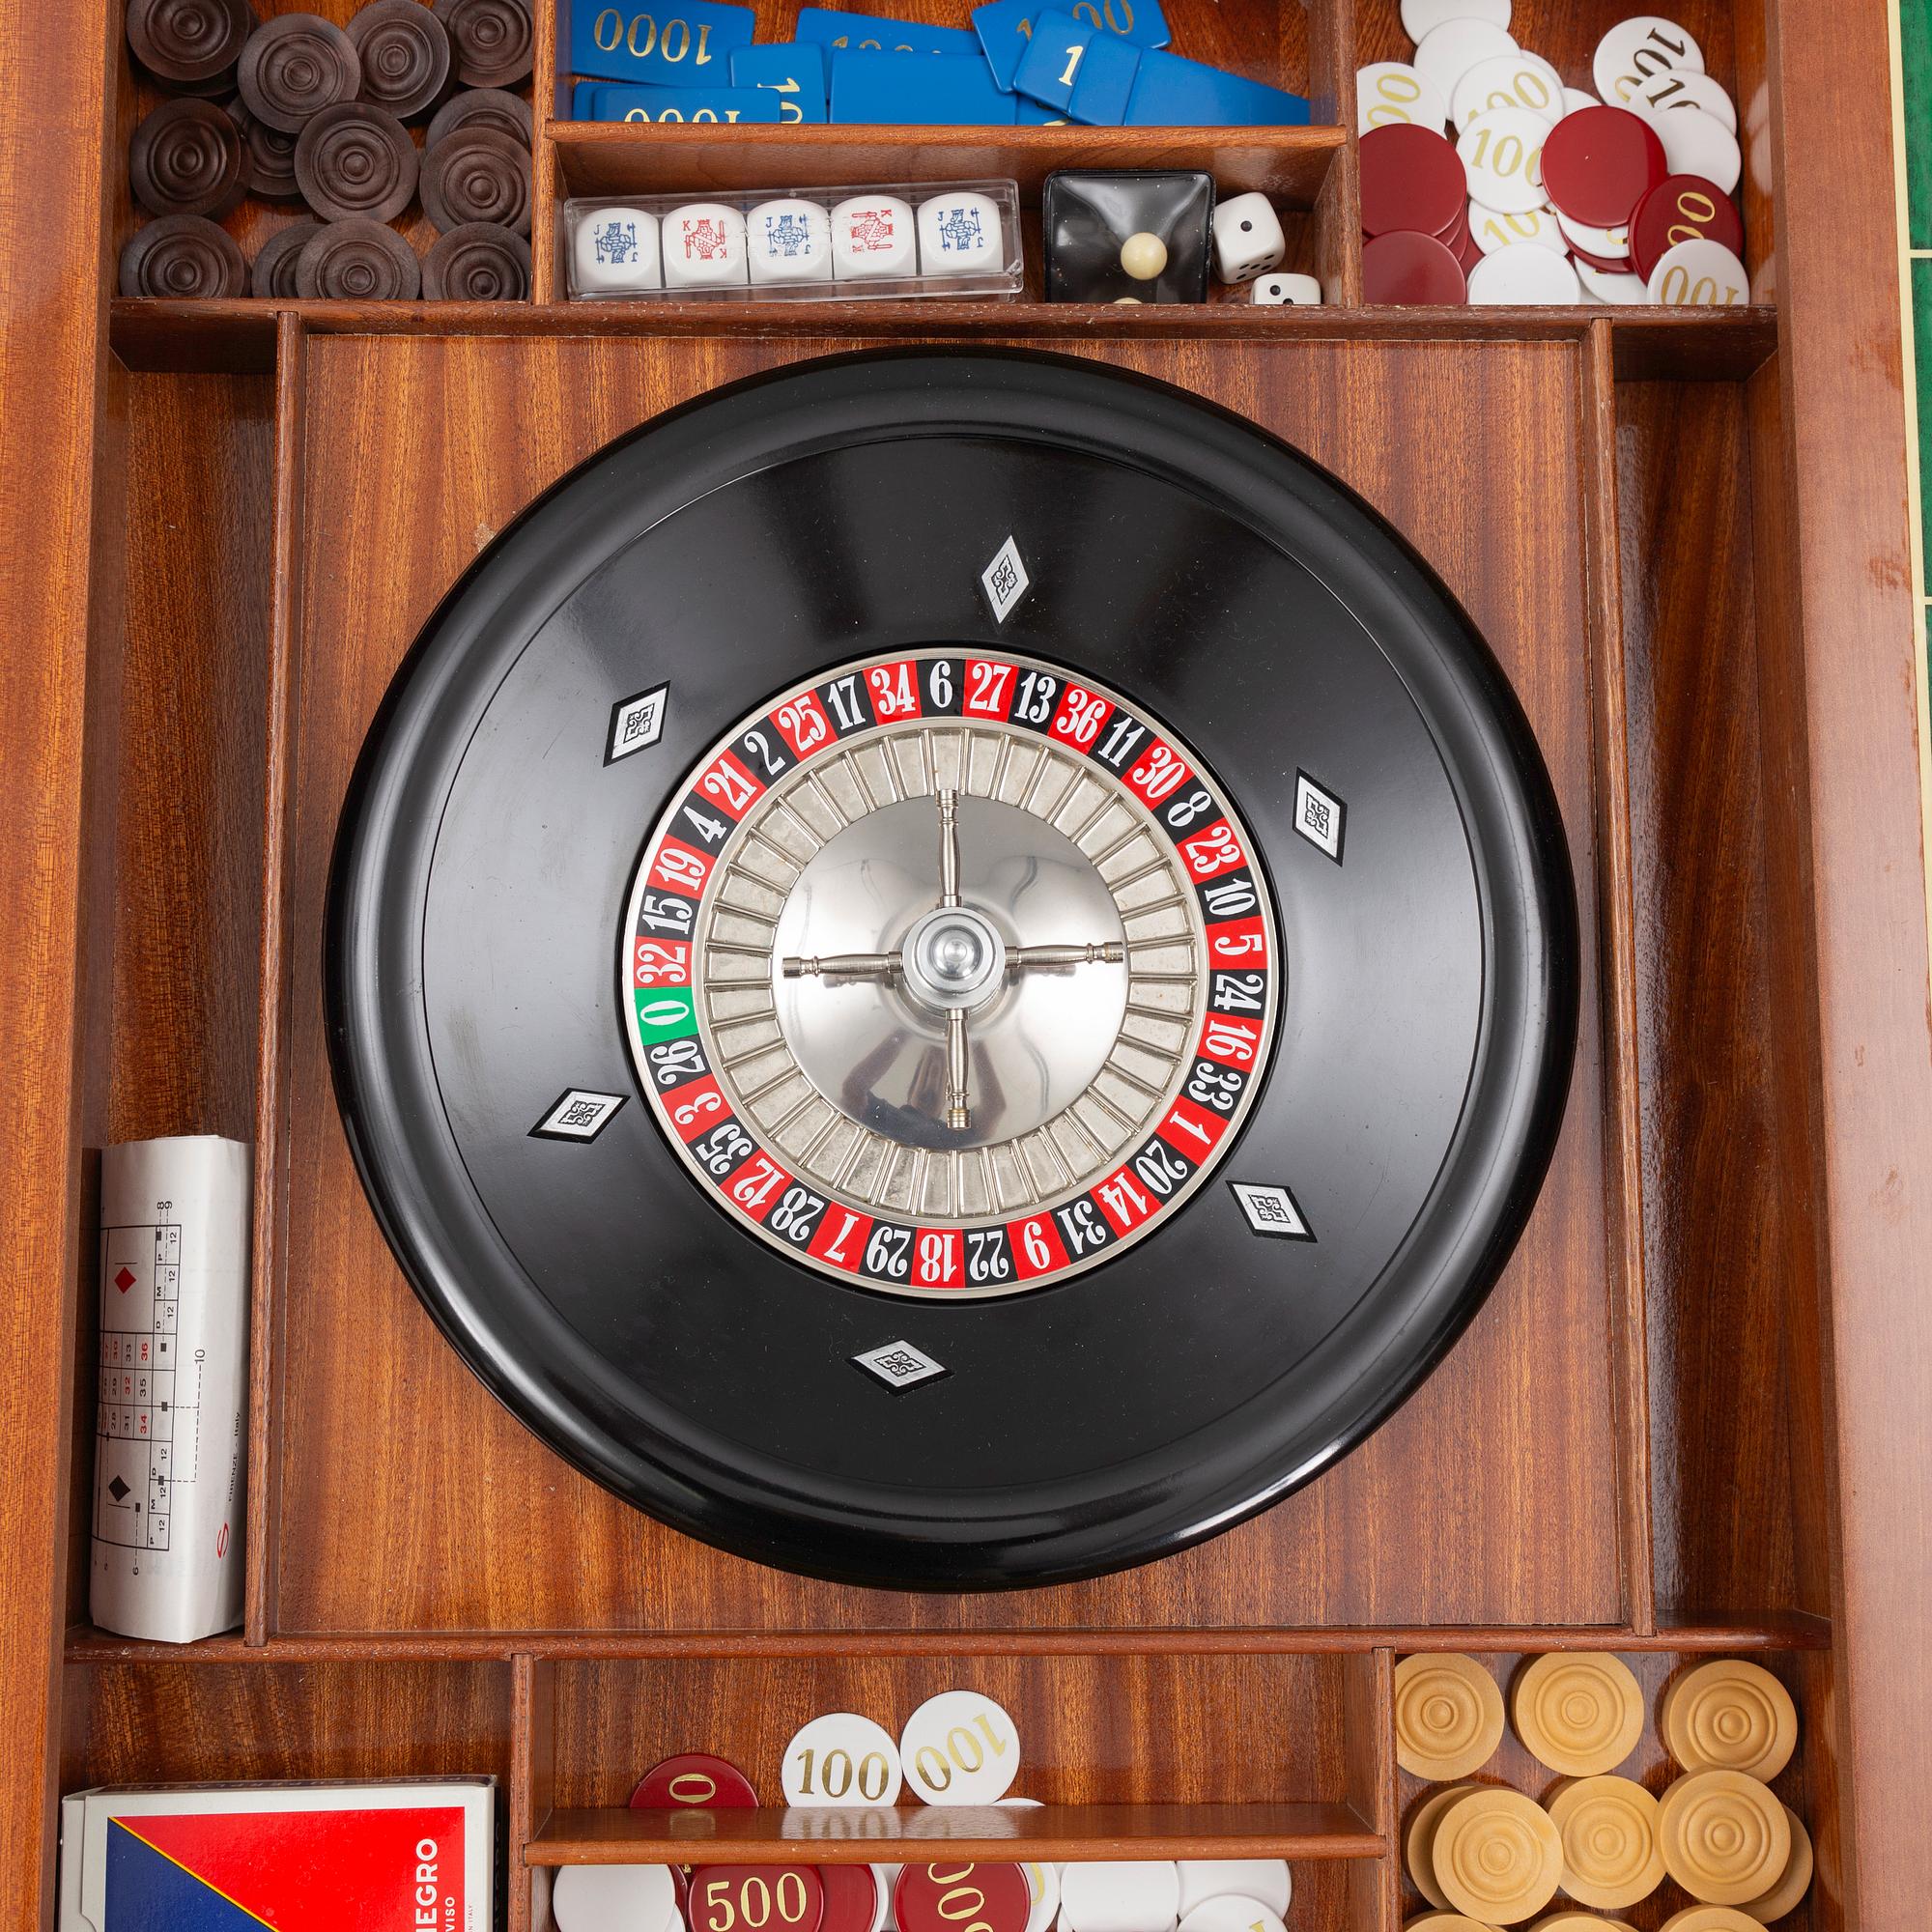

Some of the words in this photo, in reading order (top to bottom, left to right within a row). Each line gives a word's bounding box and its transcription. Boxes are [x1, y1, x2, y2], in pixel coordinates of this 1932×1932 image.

[593, 8, 713, 65] 1000
[593, 224, 601, 236] J
[683, 220, 692, 232] K
[766, 216, 773, 227] J
[937, 212, 944, 221] J
[828, 675, 866, 730] 17
[871, 664, 915, 716] 34
[929, 661, 952, 707] 6
[969, 663, 1011, 712] 27
[1014, 671, 1056, 724] 13
[778, 696, 827, 752] 25
[1056, 689, 1106, 742] 36
[744, 730, 786, 775] 2
[1097, 716, 1145, 767] 11
[704, 758, 756, 810] 21
[1133, 747, 1185, 798] 30
[683, 806, 726, 842] 4
[1168, 791, 1211, 826] 8
[655, 847, 706, 891] 19
[1185, 826, 1240, 873] 23
[642, 895, 693, 934] 15
[1204, 878, 1256, 915] 10
[637, 943, 686, 983] 32
[1214, 934, 1264, 954] 5
[639, 1001, 690, 1025] 0
[1214, 974, 1264, 1010] 24
[650, 1040, 706, 1085] 26
[1206, 1020, 1257, 1061] 16
[674, 1092, 722, 1124] 3
[1188, 1063, 1241, 1110] 33
[696, 1124, 753, 1175] 35
[1170, 1111, 1211, 1145] 1
[733, 1158, 784, 1208] 12
[1135, 1139, 1187, 1194] 20
[157, 1201, 164, 1209] 8
[165, 1201, 173, 1209] 9
[771, 1187, 824, 1241] 28
[1098, 1172, 1149, 1226] 14
[170, 1232, 177, 1244] 12
[824, 1212, 860, 1263] 7
[1024, 1221, 1051, 1269] 9
[1058, 1201, 1106, 1255] 31
[866, 1226, 912, 1276] 29
[920, 1234, 958, 1282] 18
[968, 1231, 1009, 1280] 22
[169, 1270, 176, 1283] 12
[167, 1306, 174, 1318] 12
[126, 1344, 131, 1362] 33
[141, 1343, 149, 1361] 36
[194, 1349, 206, 1364] 10
[125, 1377, 130, 1395] 32
[140, 1378, 147, 1397] 35
[140, 1415, 148, 1434] 34
[160, 1448, 167, 1461] 12
[160, 1487, 166, 1499] 12
[158, 1520, 165, 1531] 12
[915, 1713, 1008, 1792] 100
[797, 1748, 889, 1802] 100
[415, 1838, 438, 1932] EGRO
[706, 1872, 807, 1932] 500
